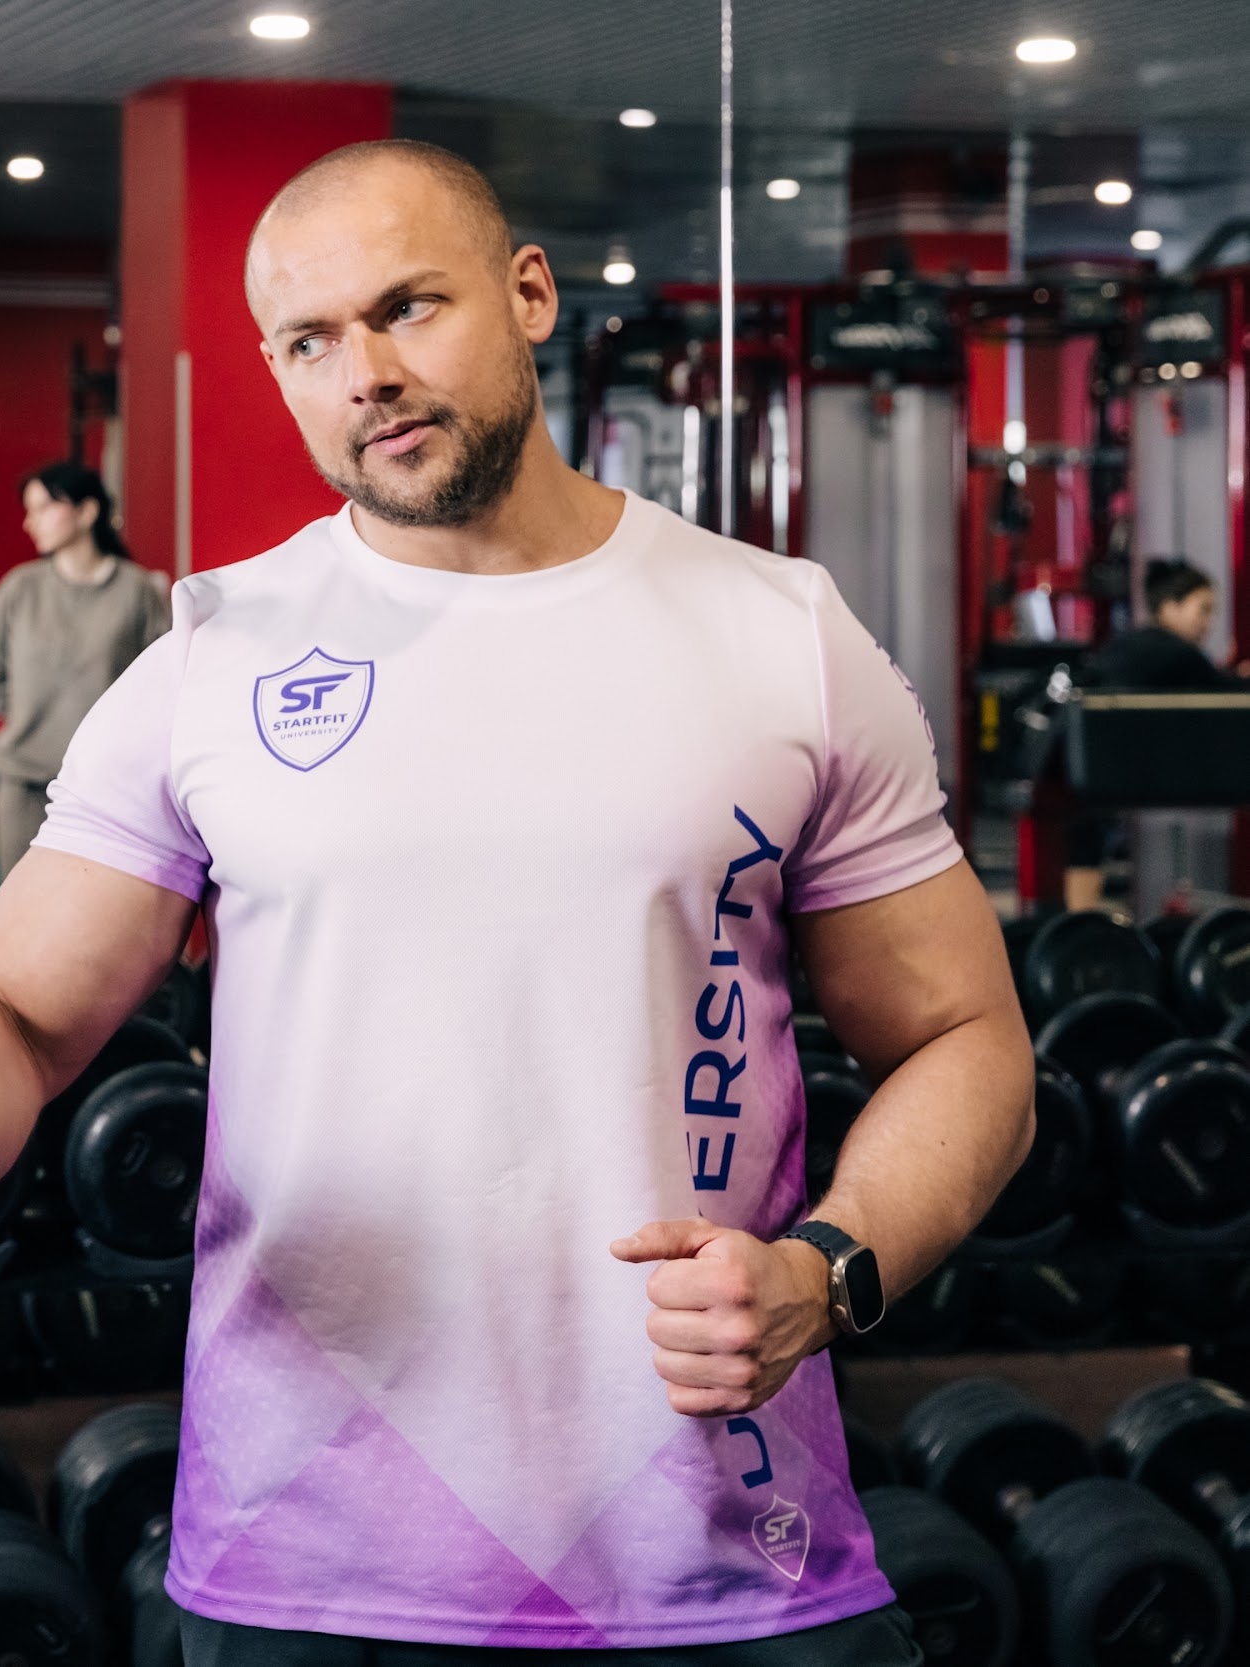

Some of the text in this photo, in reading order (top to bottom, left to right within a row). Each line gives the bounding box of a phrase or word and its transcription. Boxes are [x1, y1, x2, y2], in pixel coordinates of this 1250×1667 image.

[279, 672, 354, 713] SF
[273, 713, 348, 731] STARTFIT
[280, 728, 340, 740] UNIVERSITY
[685, 803, 784, 1489] UERSITY
[765, 1511, 798, 1543] SF
[767, 1540, 801, 1555] STARTFIT
